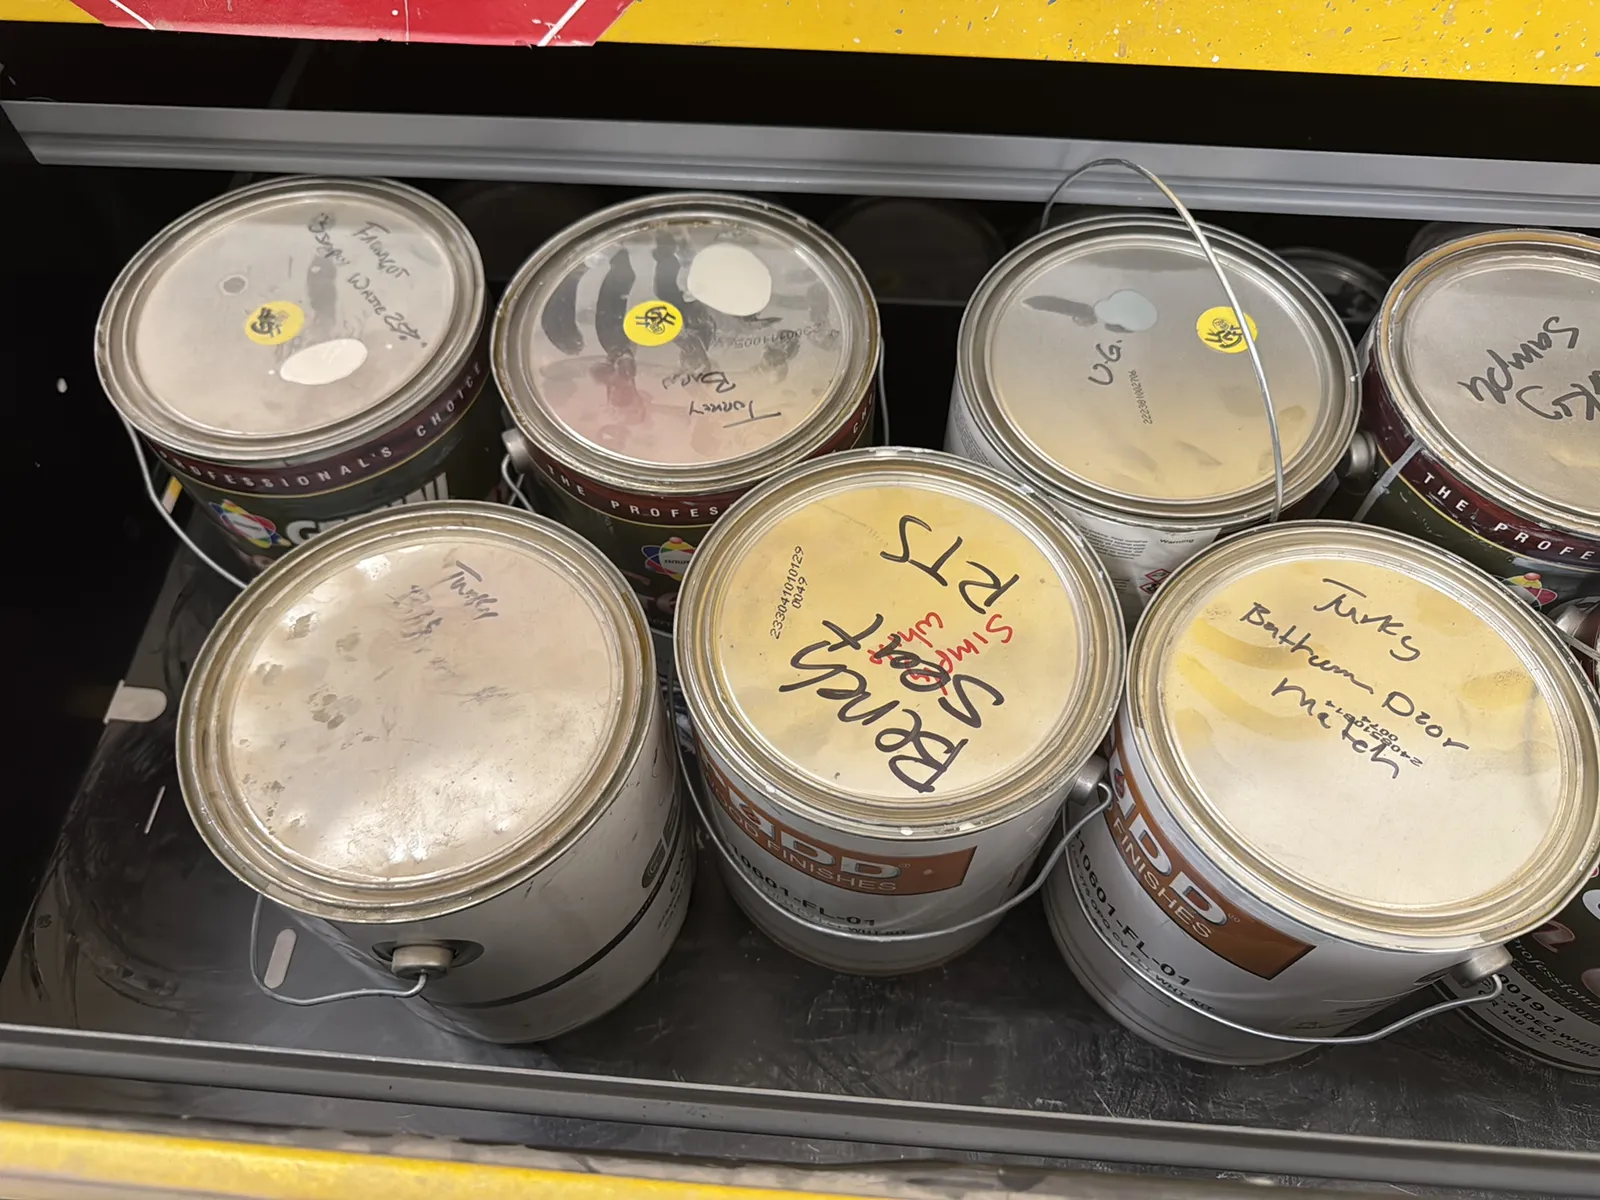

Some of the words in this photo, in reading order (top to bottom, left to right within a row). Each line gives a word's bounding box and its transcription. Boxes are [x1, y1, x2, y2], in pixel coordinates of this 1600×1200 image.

[415, 361, 483, 438] CHOICE
[548, 465, 587, 497] THE
[611, 500, 732, 518] PROFES
[1423, 472, 1467, 513] THE
[769, 545, 805, 640] 233041010129
[790, 576, 809, 609] 0049
[1360, 715, 1399, 742] 0074
[767, 840, 898, 892] FINISHES
[1113, 816, 1212, 939] FINISHES
[1074, 829, 1191, 987] 10601-FL-01
